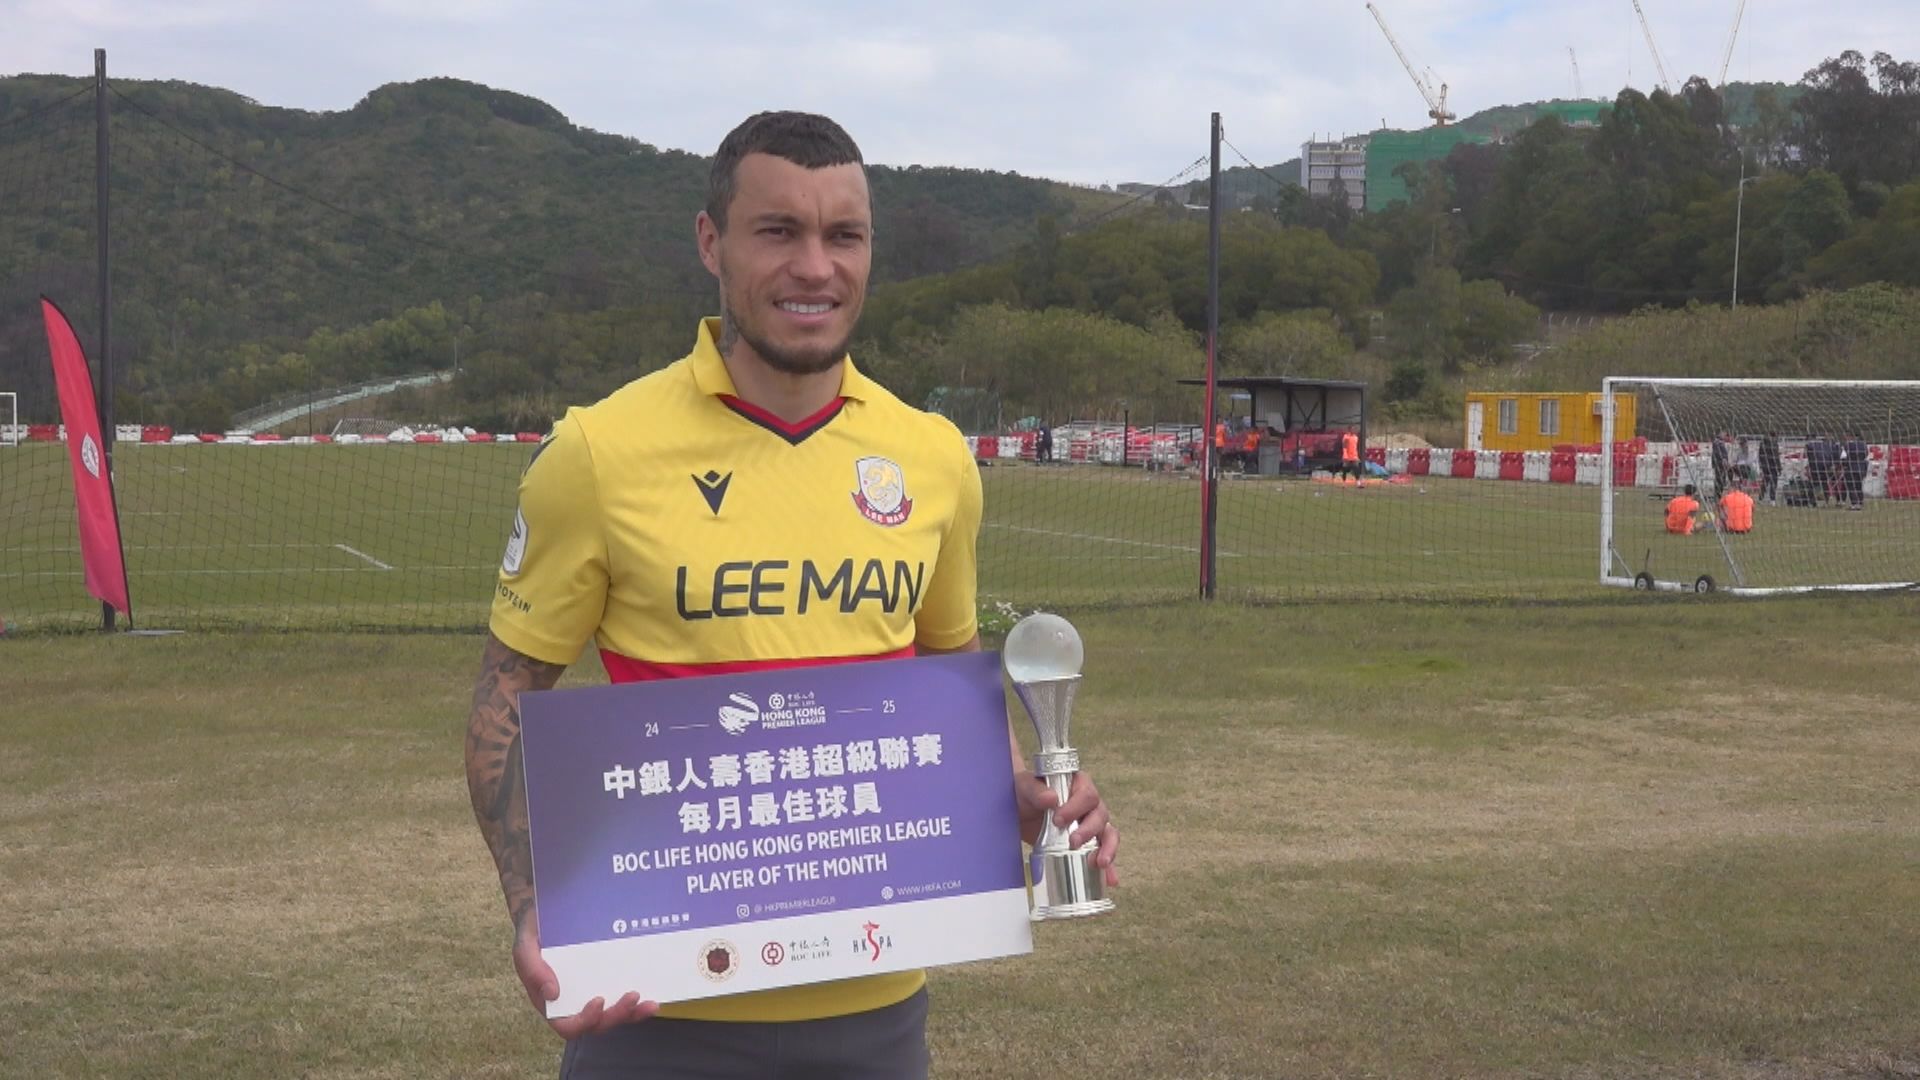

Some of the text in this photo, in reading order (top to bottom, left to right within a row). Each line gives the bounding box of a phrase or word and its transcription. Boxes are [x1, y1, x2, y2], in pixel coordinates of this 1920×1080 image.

[676, 558, 924, 621] LEE MAN
[761, 706, 826, 721] HONG KONG
[762, 716, 827, 729] PREMIER LEAGUE
[883, 700, 896, 713] 25
[645, 722, 659, 737] 24
[603, 734, 942, 799] 中銀人壽香港超級聯賽
[678, 782, 881, 833] 每月最佳球員
[612, 816, 951, 873] BOC LIFE HONG KONG PREMIER LEAGUE
[687, 853, 887, 895] PLAYER OF THE MONTH
